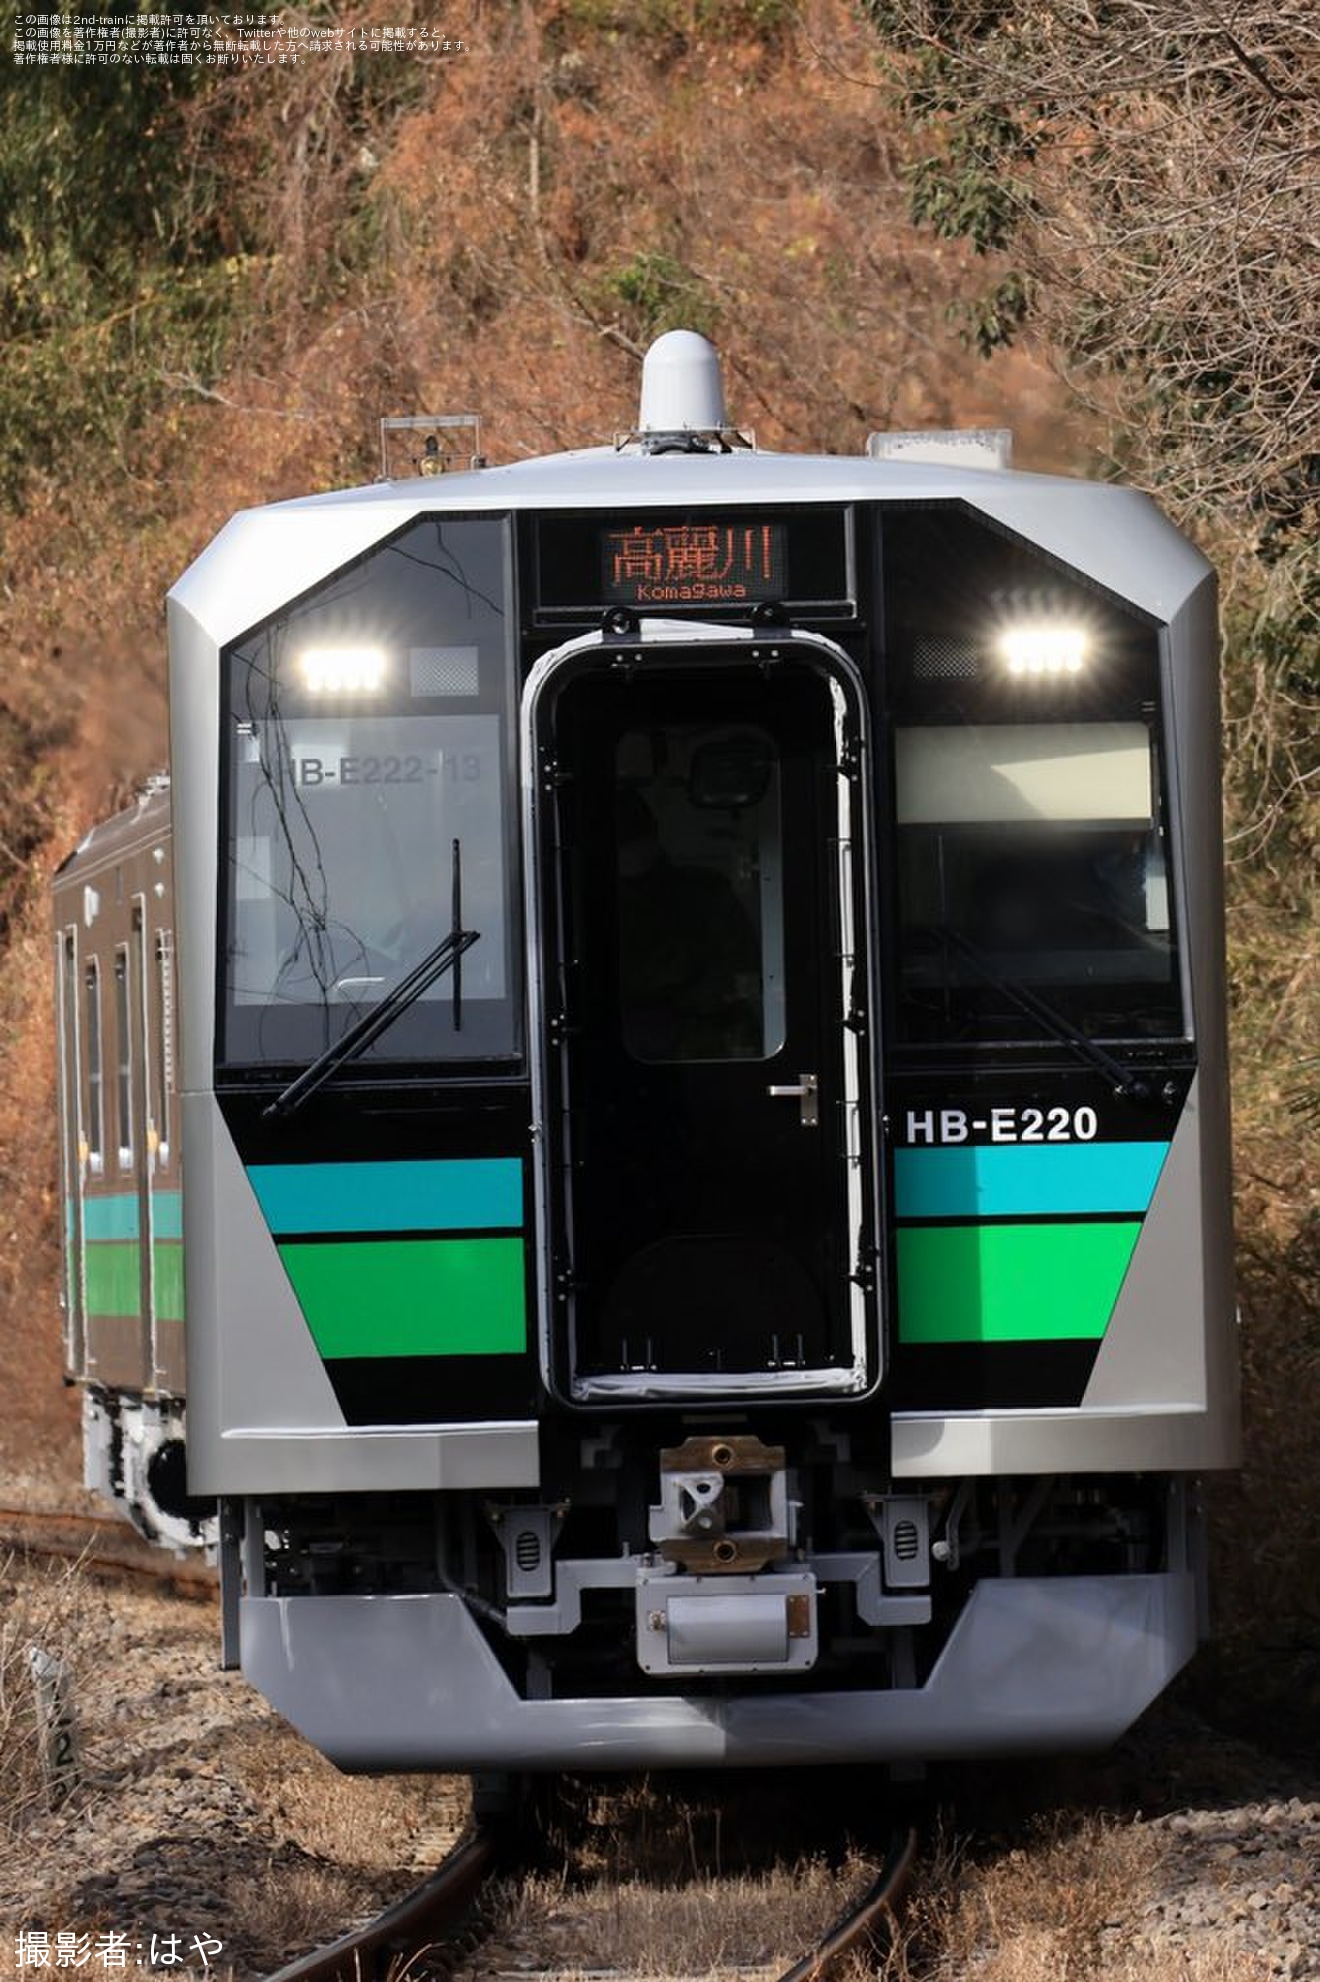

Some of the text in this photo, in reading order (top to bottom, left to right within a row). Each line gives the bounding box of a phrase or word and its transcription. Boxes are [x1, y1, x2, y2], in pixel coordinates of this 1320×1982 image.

[607, 526, 772, 586] 高麗川
[636, 583, 747, 600] Komagawa
[907, 1106, 1098, 1143] HB-E220
